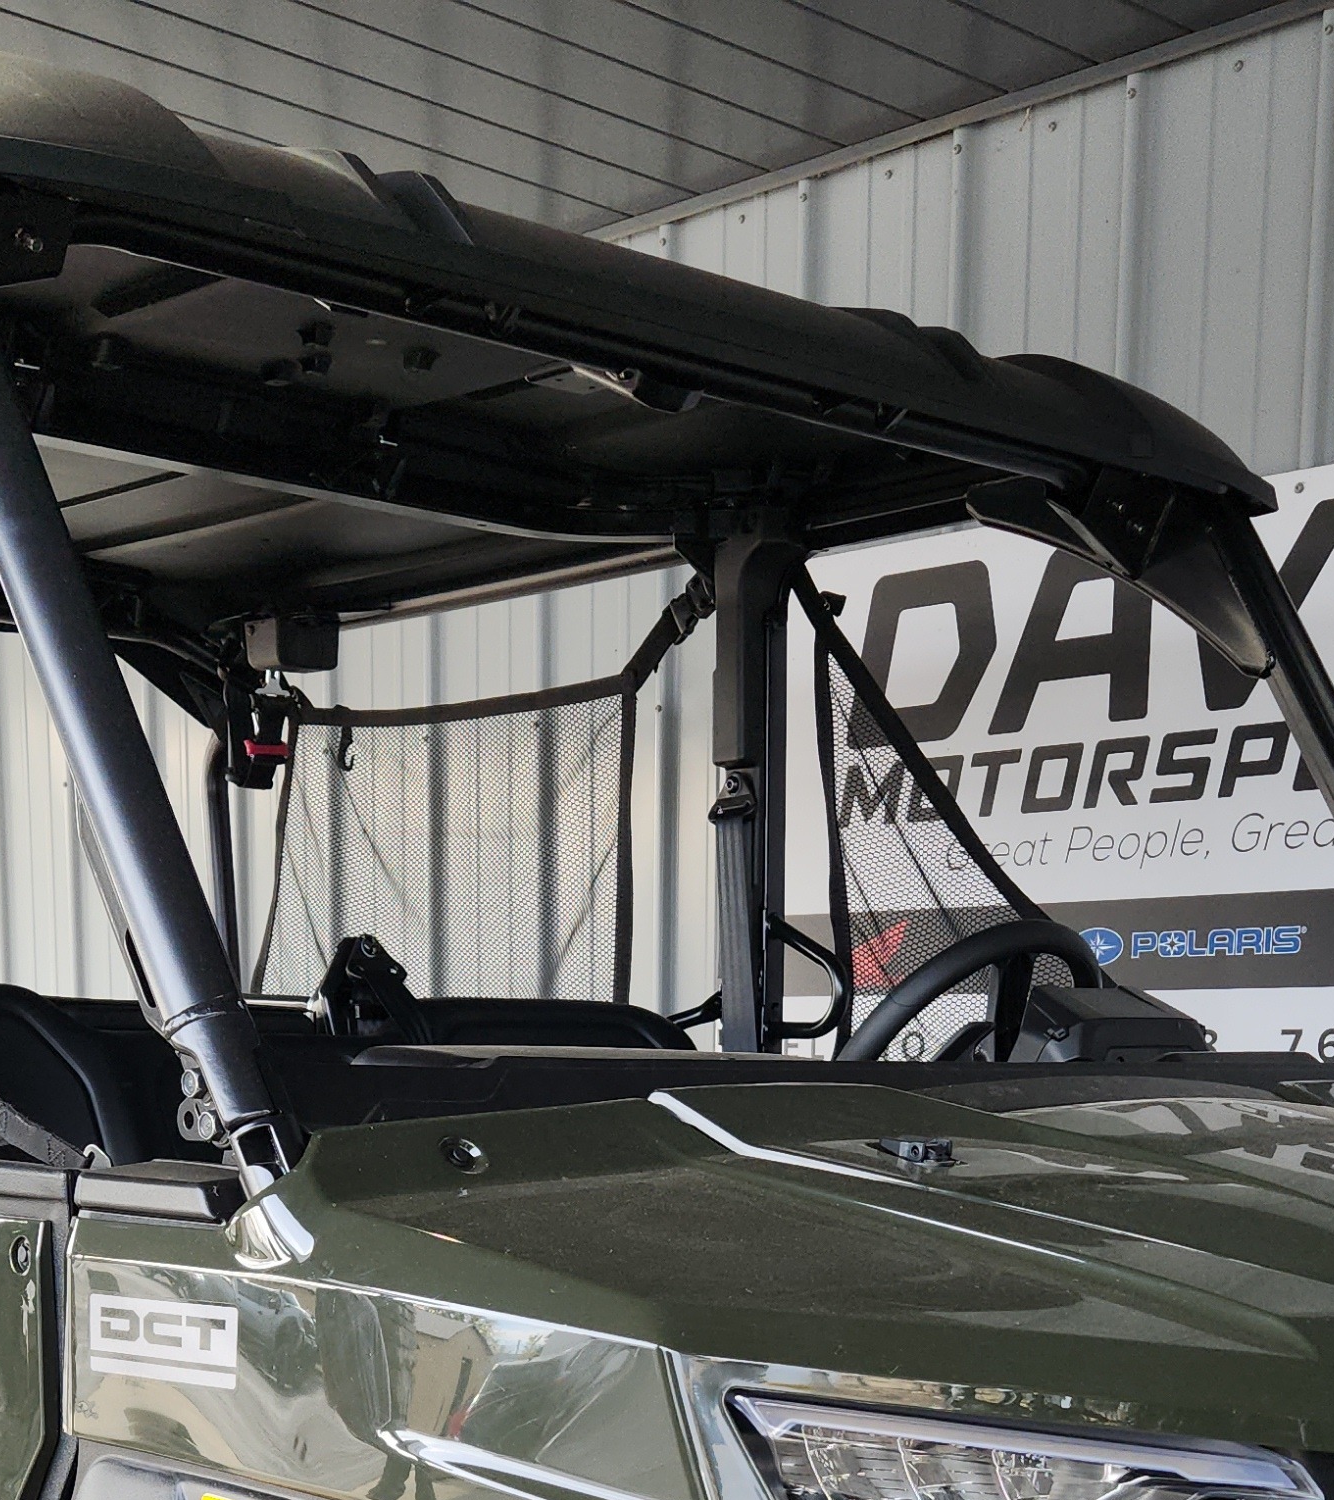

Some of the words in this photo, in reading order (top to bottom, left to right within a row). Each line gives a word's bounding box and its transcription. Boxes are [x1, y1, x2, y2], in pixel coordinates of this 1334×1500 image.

[947, 832, 1053, 871] Geat
[1065, 819, 1210, 870] People,
[1130, 925, 1302, 959] POLARIS
[100, 1306, 227, 1351] DCT
